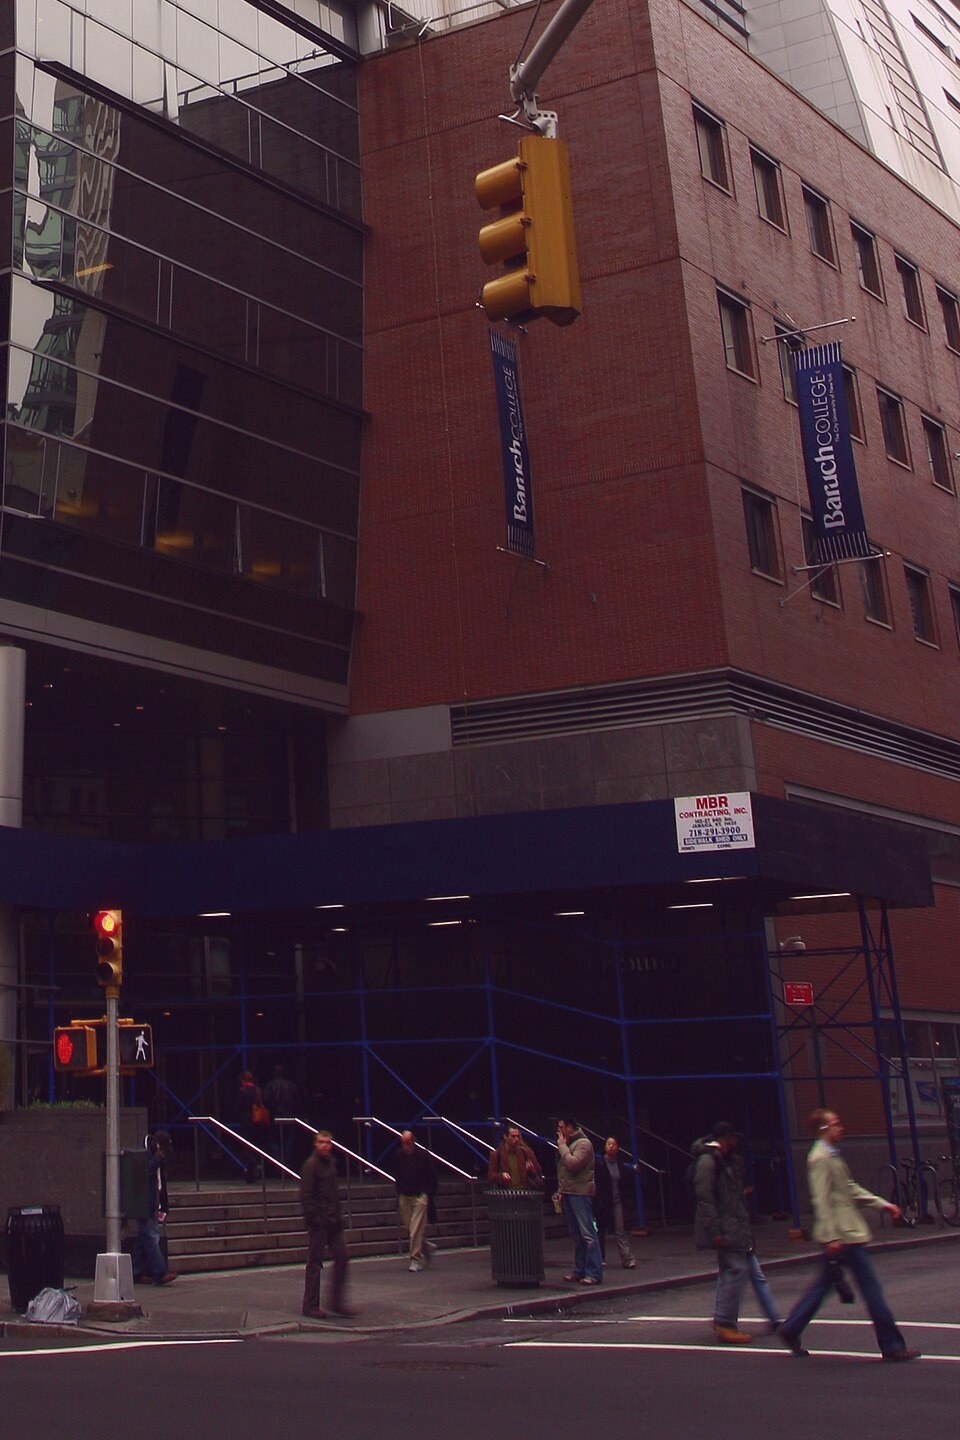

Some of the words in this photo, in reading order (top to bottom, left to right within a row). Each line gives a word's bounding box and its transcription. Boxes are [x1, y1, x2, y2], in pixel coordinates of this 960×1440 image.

[696, 796, 728, 810] MBR
[679, 809, 731, 819] CONTRACTING,
[689, 826, 741, 837] 718-291-3900
